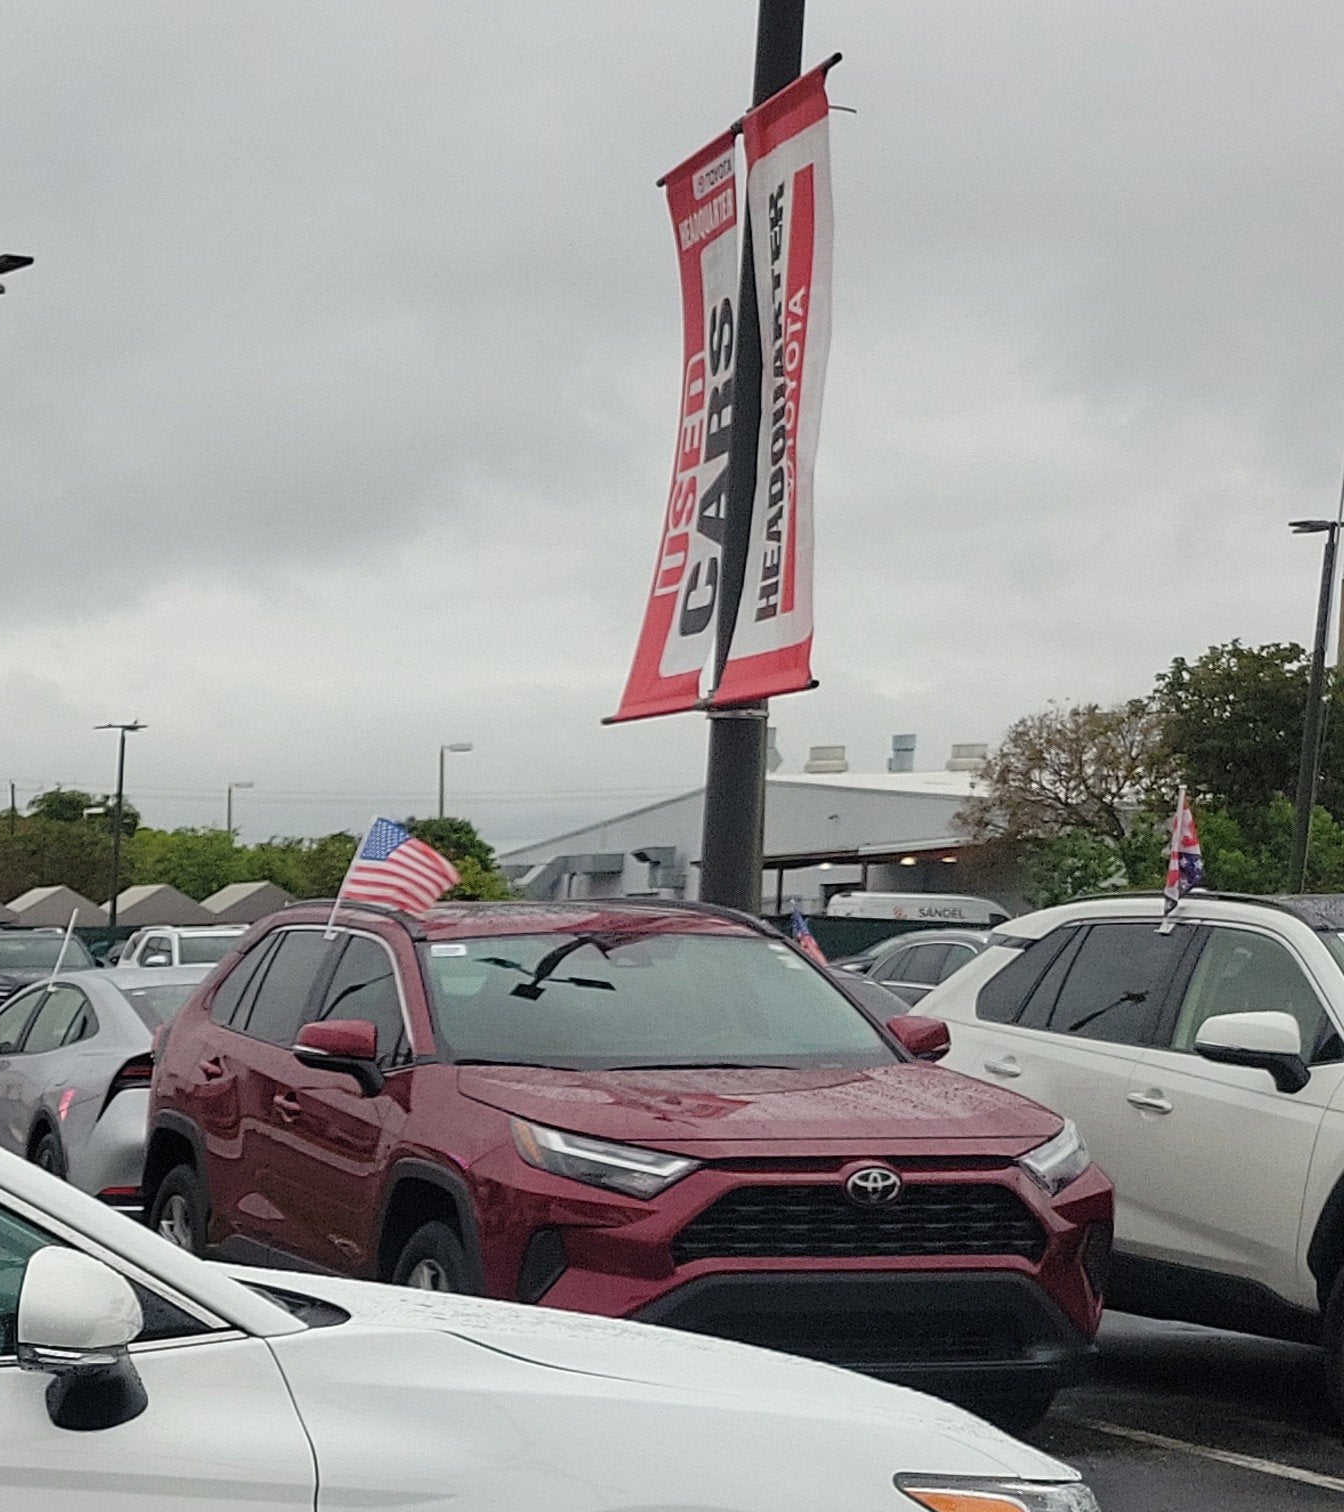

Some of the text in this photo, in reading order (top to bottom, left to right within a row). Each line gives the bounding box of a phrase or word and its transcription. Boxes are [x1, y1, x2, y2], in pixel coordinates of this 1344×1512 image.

[654, 351, 706, 597] USED
[679, 297, 734, 637] CARS
[754, 180, 786, 623] HEADQUARTER
